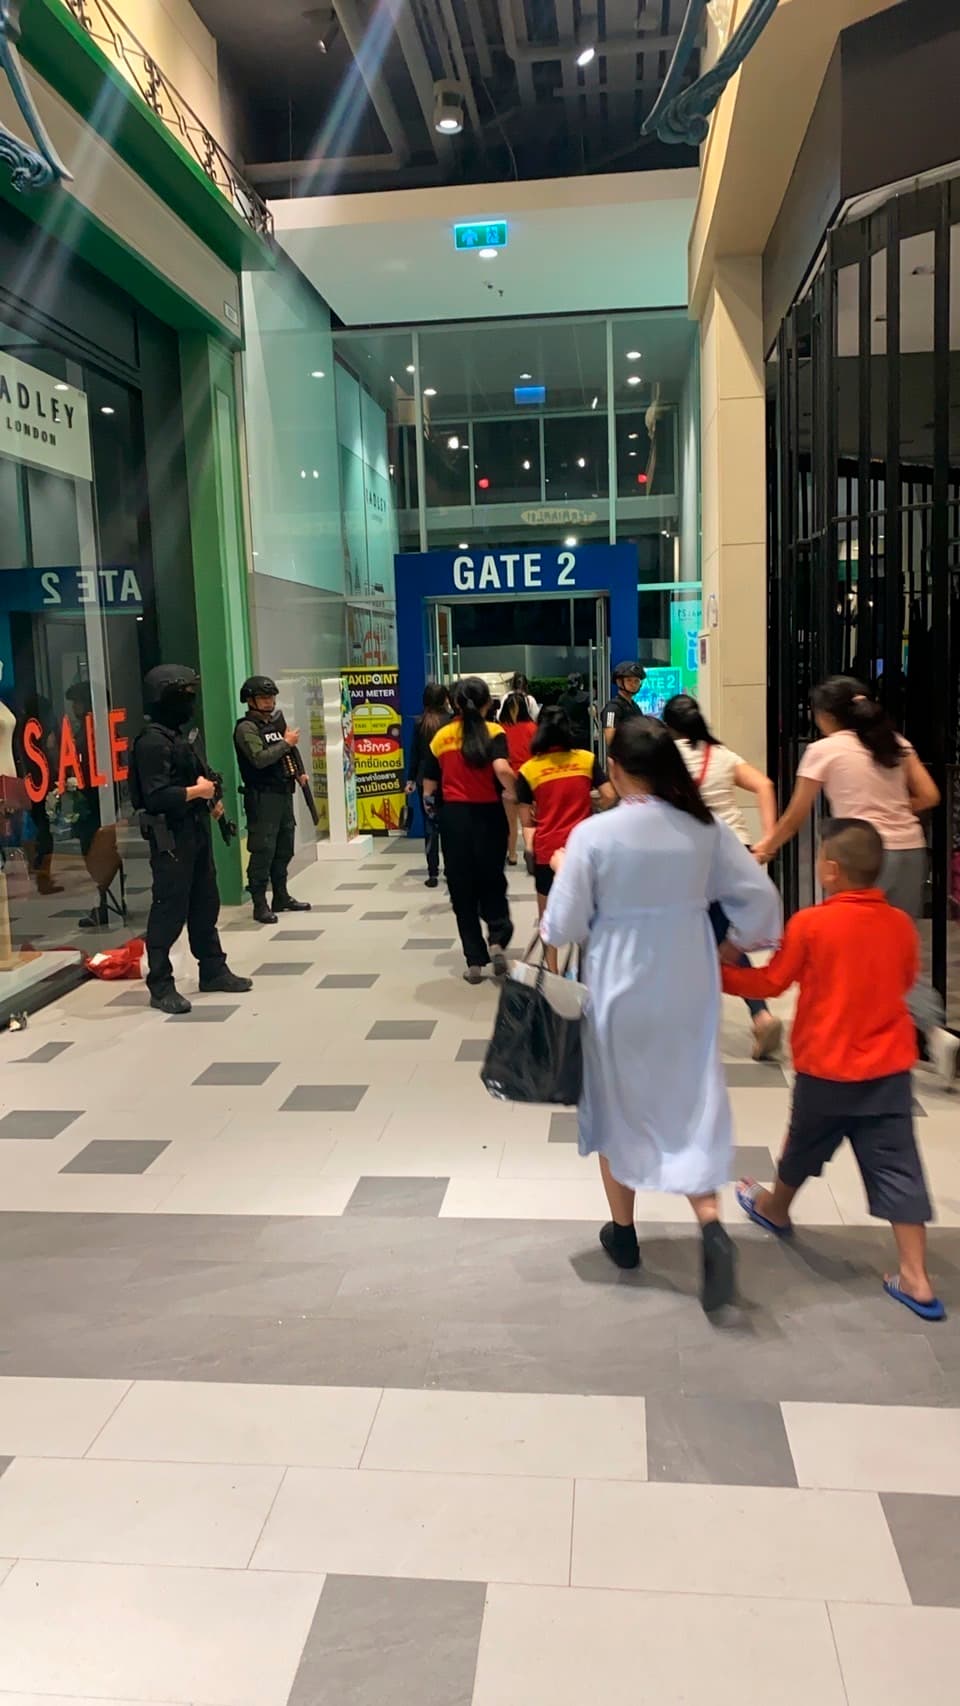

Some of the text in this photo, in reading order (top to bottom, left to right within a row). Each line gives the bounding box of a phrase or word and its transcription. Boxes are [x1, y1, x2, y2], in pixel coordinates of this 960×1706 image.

[0, 374, 74, 429] ADLEY
[6, 416, 57, 446] LONDON
[453, 551, 577, 591] GATE 2
[366, 689, 395, 698] METER
[639, 675, 675, 689] ATE 2
[264, 731, 284, 743] POLI
[24, 707, 129, 803] SALE
